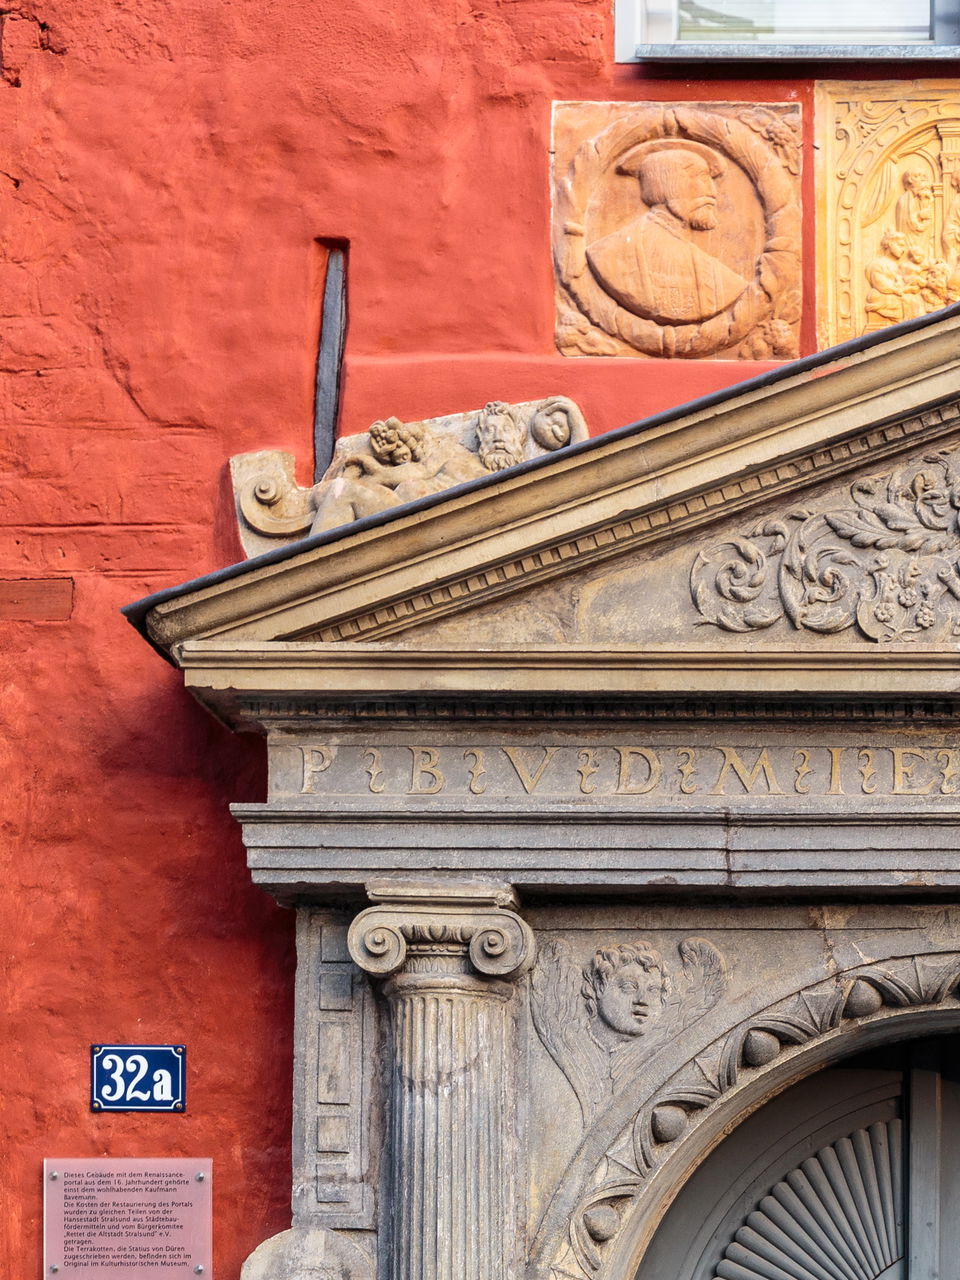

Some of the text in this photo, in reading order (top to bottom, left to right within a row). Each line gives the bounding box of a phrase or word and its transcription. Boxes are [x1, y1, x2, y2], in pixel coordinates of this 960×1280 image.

[300, 746, 333, 795] P
[407, 747, 444, 795] B
[613, 747, 660, 795] D
[707, 747, 785, 796] M
[101, 1054, 174, 1102] 32a
